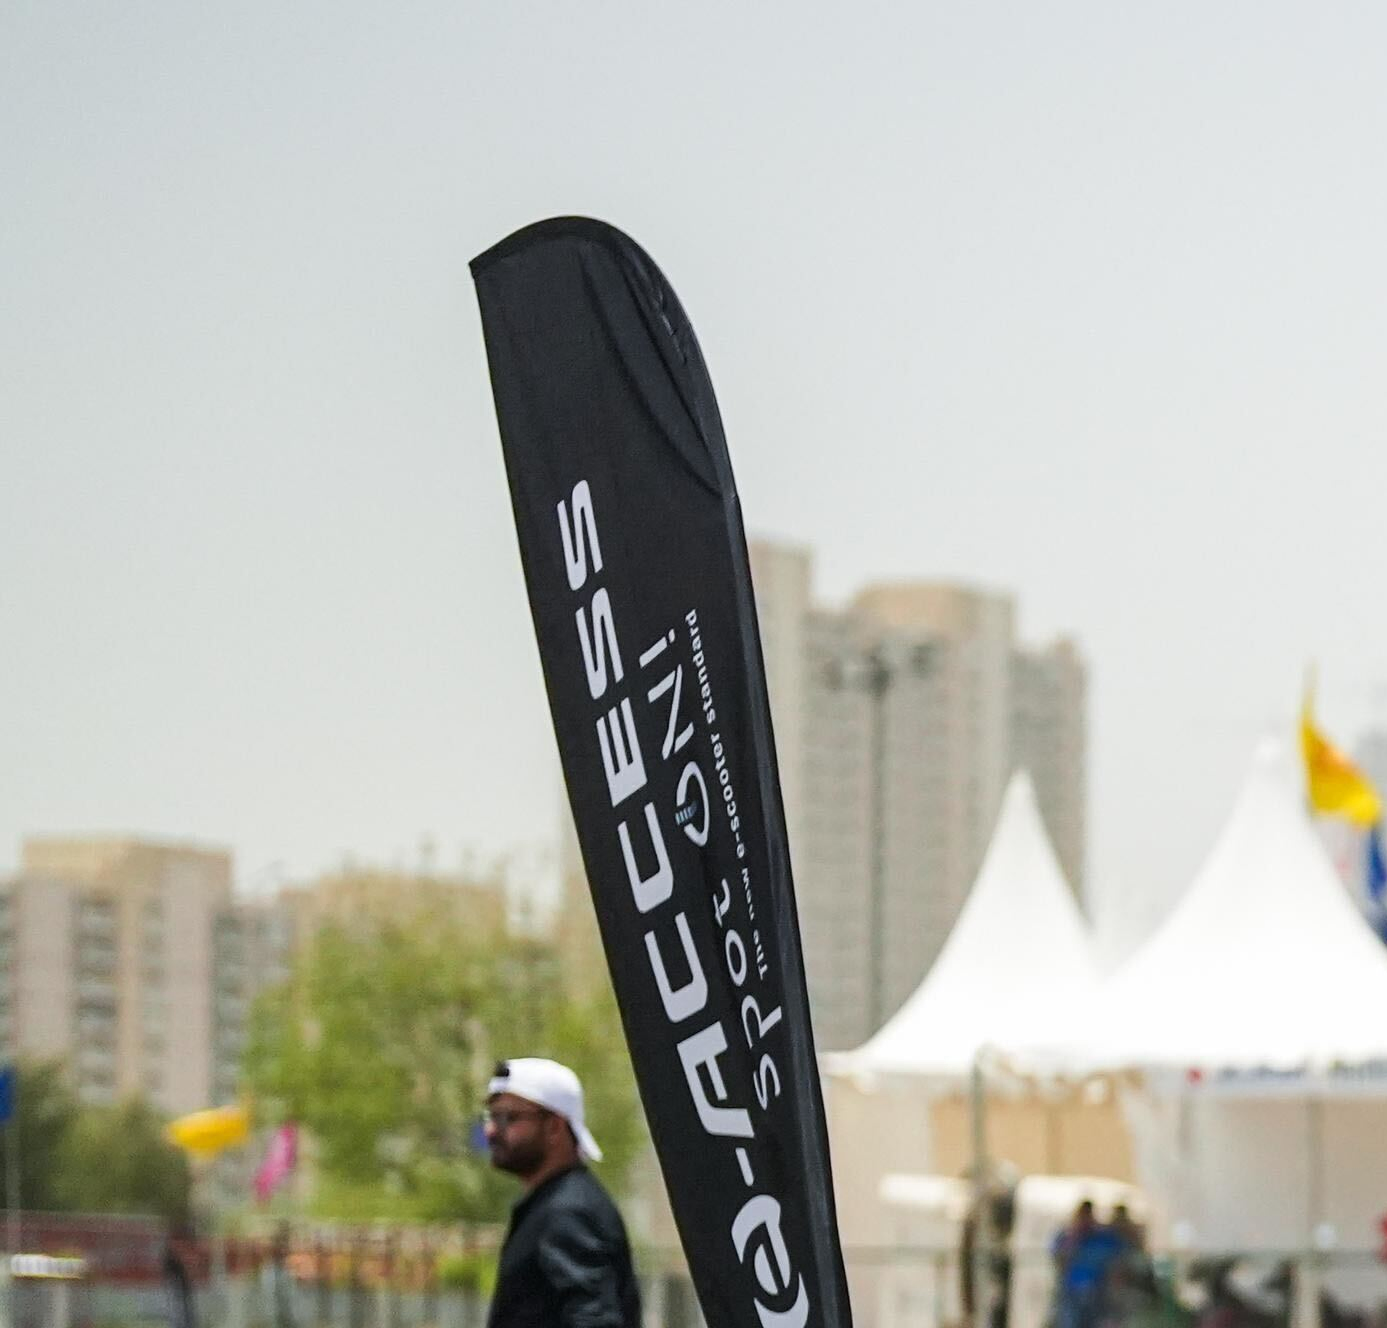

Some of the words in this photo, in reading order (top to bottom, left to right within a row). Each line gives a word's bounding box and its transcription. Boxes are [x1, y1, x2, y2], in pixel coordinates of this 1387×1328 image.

[684, 608, 717, 725] standard
[710, 732, 746, 859] e-scooter
[741, 866, 755, 921] new
[752, 928, 769, 981] The
